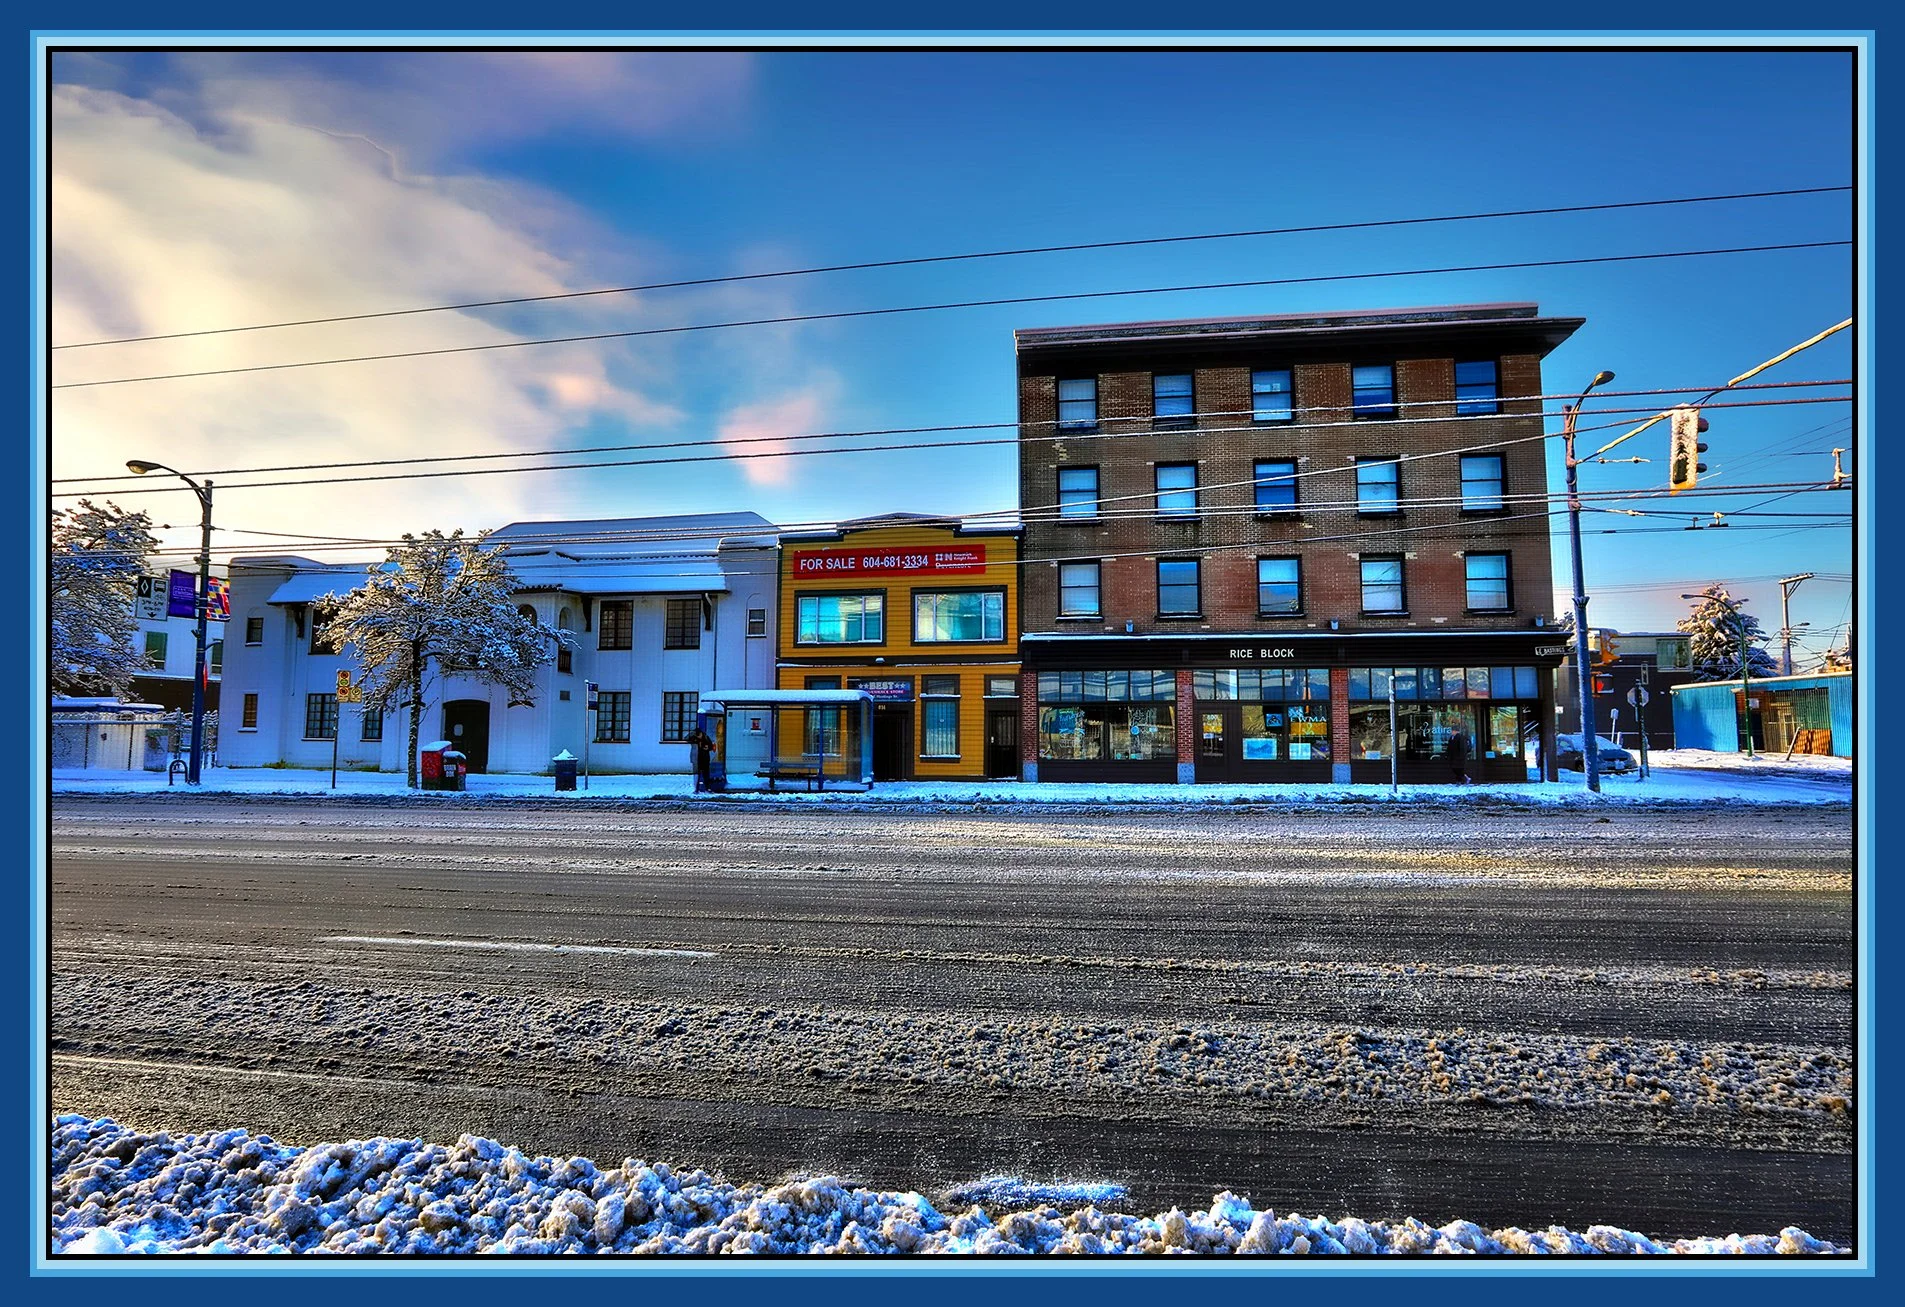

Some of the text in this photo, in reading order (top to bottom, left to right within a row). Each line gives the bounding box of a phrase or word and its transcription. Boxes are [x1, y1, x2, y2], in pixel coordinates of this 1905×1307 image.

[800, 558, 823, 571] FOR
[826, 557, 856, 570] SALE
[862, 554, 929, 569] 604-681-3334
[1229, 648, 1294, 658] RICE BLOCK
[869, 681, 894, 690] BEST
[1431, 726, 1452, 734] atira
